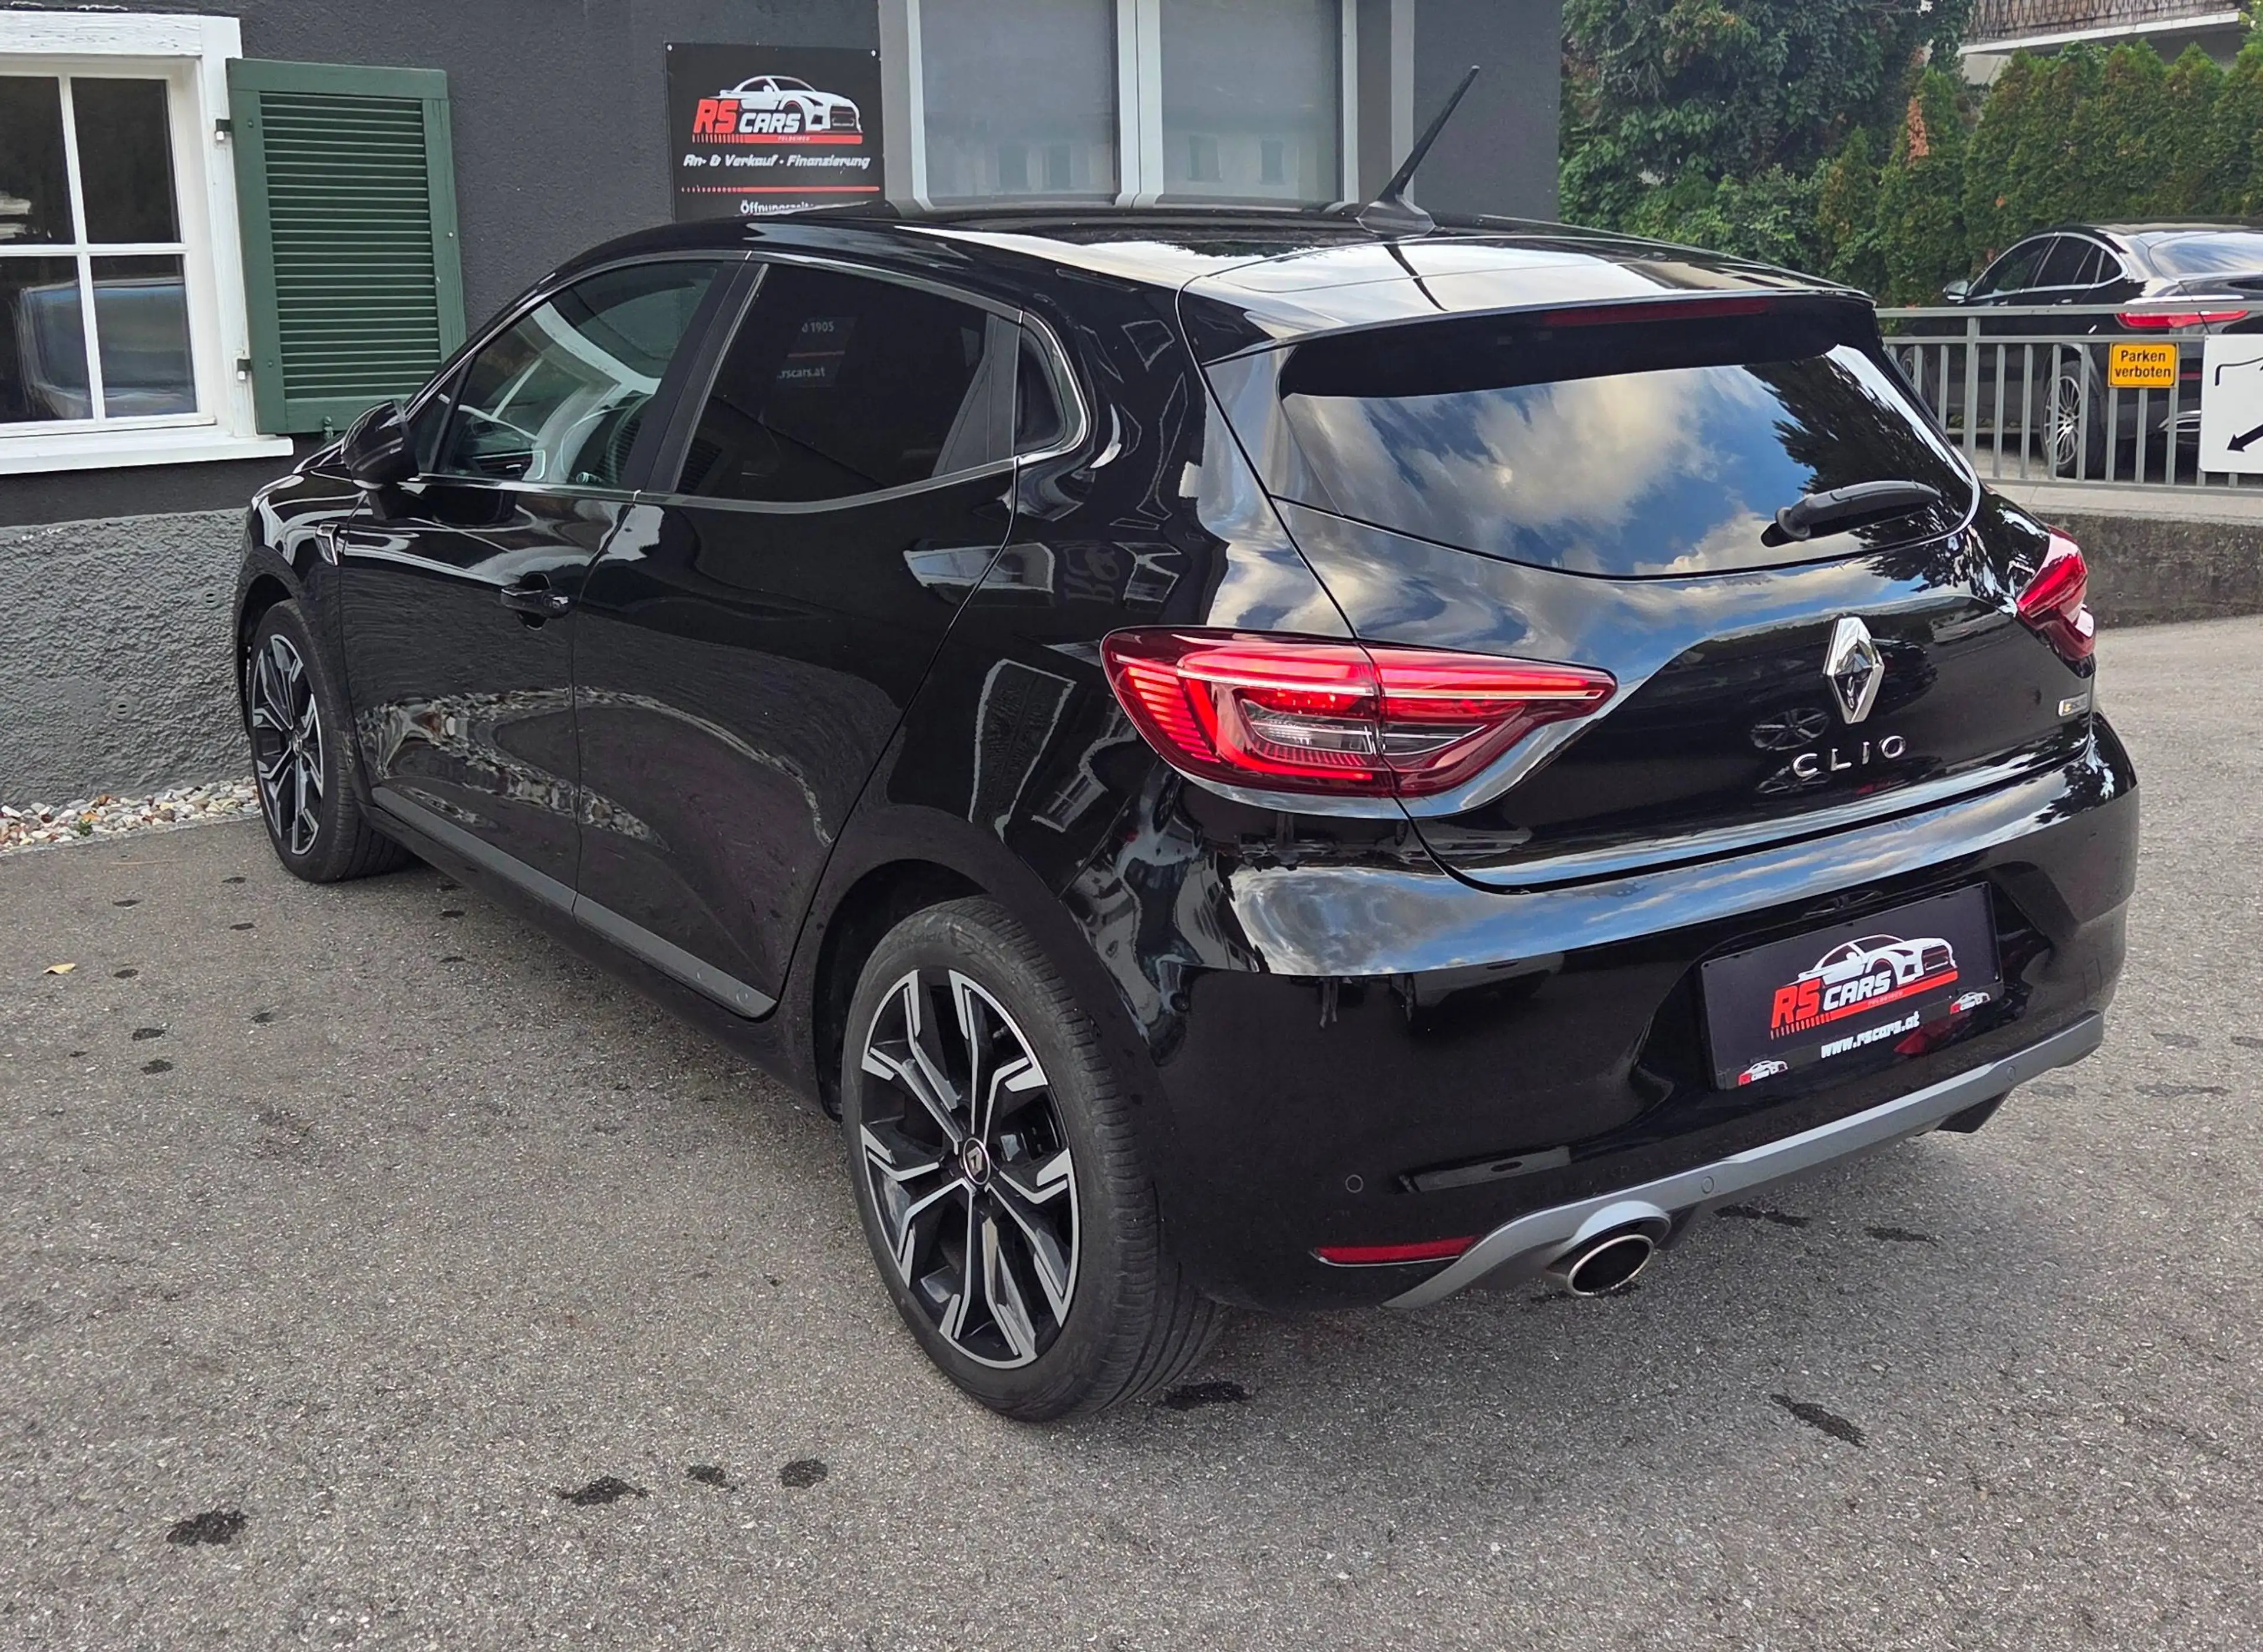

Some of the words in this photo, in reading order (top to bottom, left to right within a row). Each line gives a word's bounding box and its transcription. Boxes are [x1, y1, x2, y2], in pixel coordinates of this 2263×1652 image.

[693, 98, 739, 134] RS
[738, 112, 801, 133] CARS
[683, 154, 707, 167] An-
[724, 154, 778, 167] Verkauf
[786, 154, 871, 170] Finanzierung
[2114, 365, 2171, 378] verboten
[2120, 349, 2166, 363] Parken
[1793, 735, 1906, 778] CLIO
[1772, 978, 1821, 1029] RS
[1823, 970, 1892, 1011] CARS
[1821, 1010, 1920, 1059] www.rscars.at
